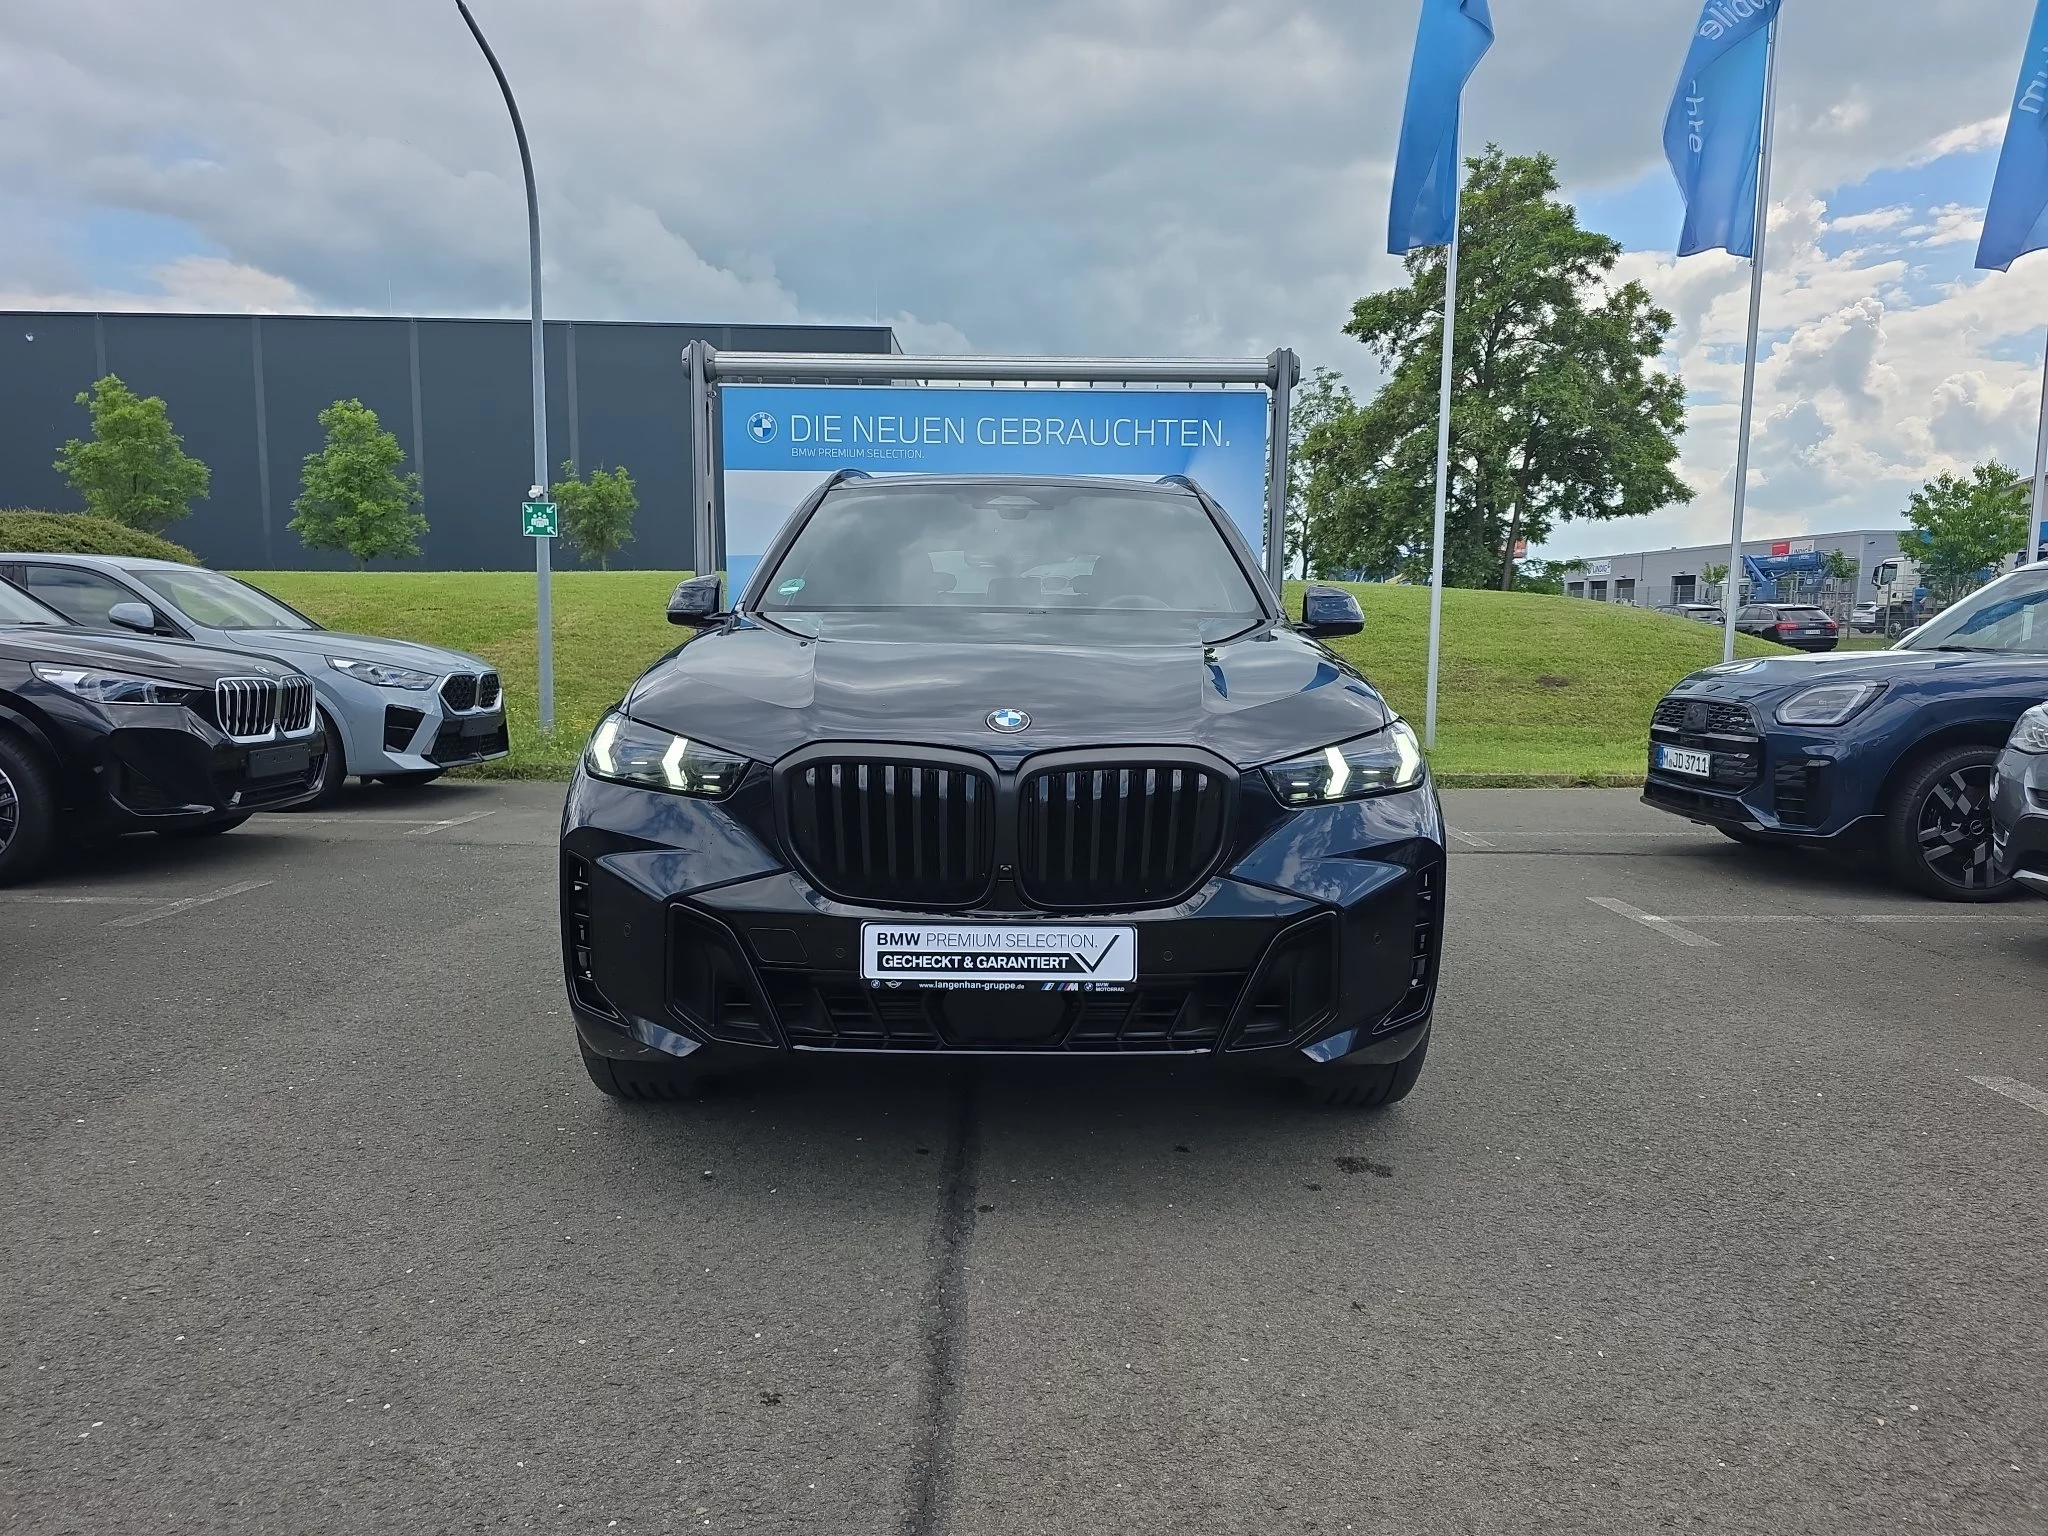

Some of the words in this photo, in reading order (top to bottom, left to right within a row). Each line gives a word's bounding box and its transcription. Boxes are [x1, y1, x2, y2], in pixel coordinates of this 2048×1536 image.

[791, 415, 843, 443] DIE
[853, 415, 965, 444] NEUEN
[976, 417, 1231, 447] GEBRAUCHTEN.
[791, 447, 817, 457] BMW
[818, 448, 865, 458] PREMIUM
[867, 449, 925, 459] SELECTION.
[1663, 750, 1669, 768] M
[1672, 752, 1684, 769] JD
[1684, 754, 1707, 774] 3711
[877, 932, 921, 946] BMW
[926, 932, 1001, 948] PREMIUM
[1005, 933, 1098, 949] SELECTION.
[882, 954, 962, 969] GECHECKT
[963, 955, 974, 969] &
[976, 956, 1070, 970] GARANTIERT
[918, 981, 1025, 991] www.langenhan-gruppe.de
